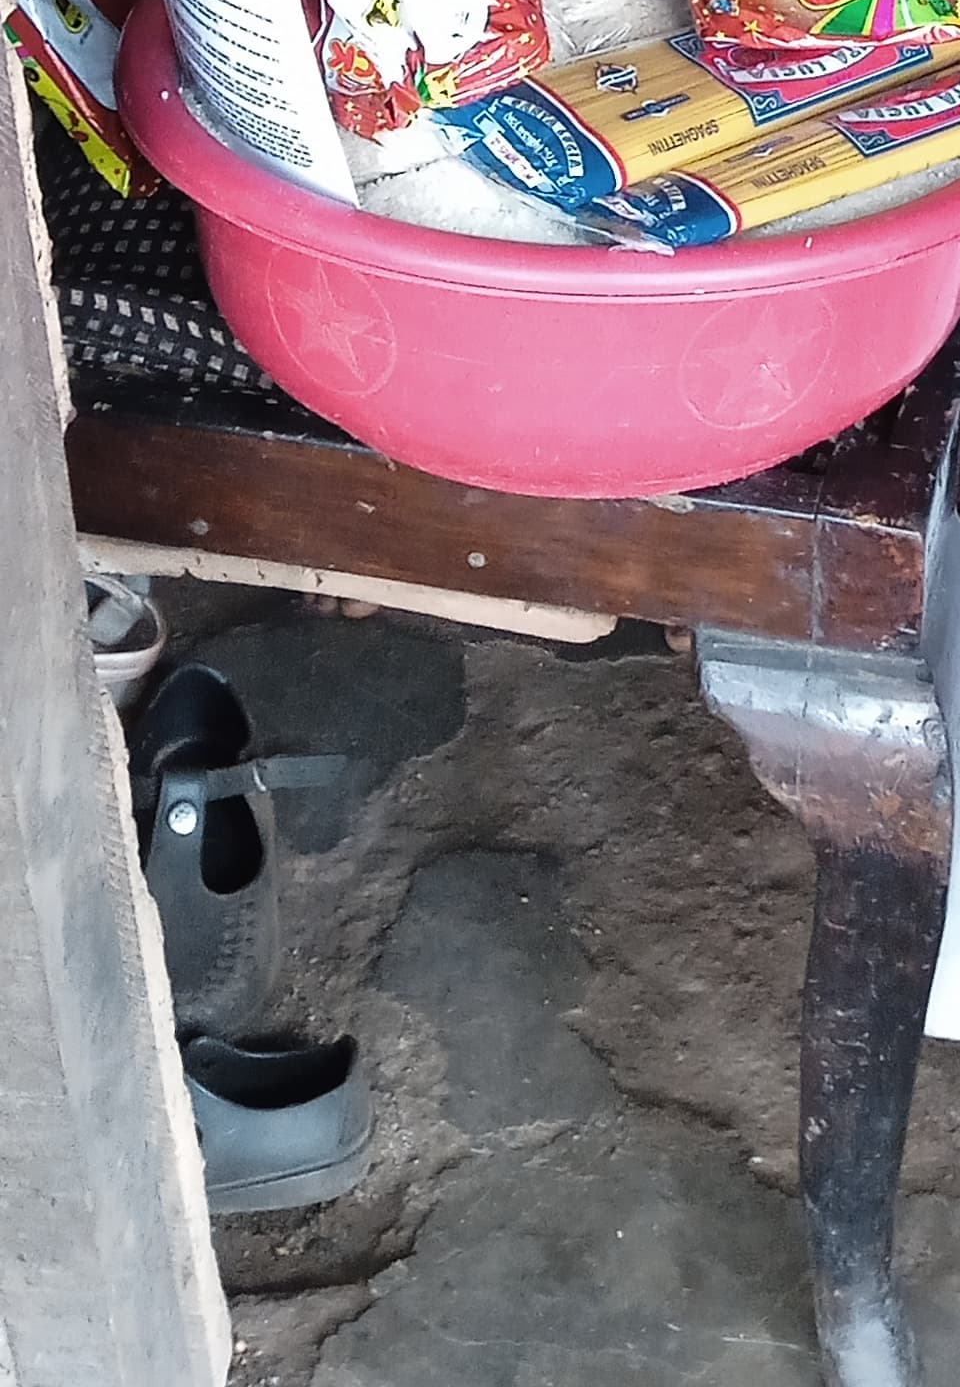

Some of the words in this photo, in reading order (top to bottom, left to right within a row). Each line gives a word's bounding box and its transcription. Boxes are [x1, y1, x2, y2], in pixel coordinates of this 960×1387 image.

[751, 60, 826, 79] LUCIA
[856, 100, 936, 120] LUCIA
[647, 119, 720, 156] SPAGHETTINI
[750, 155, 827, 190] SPAGHETTINI
